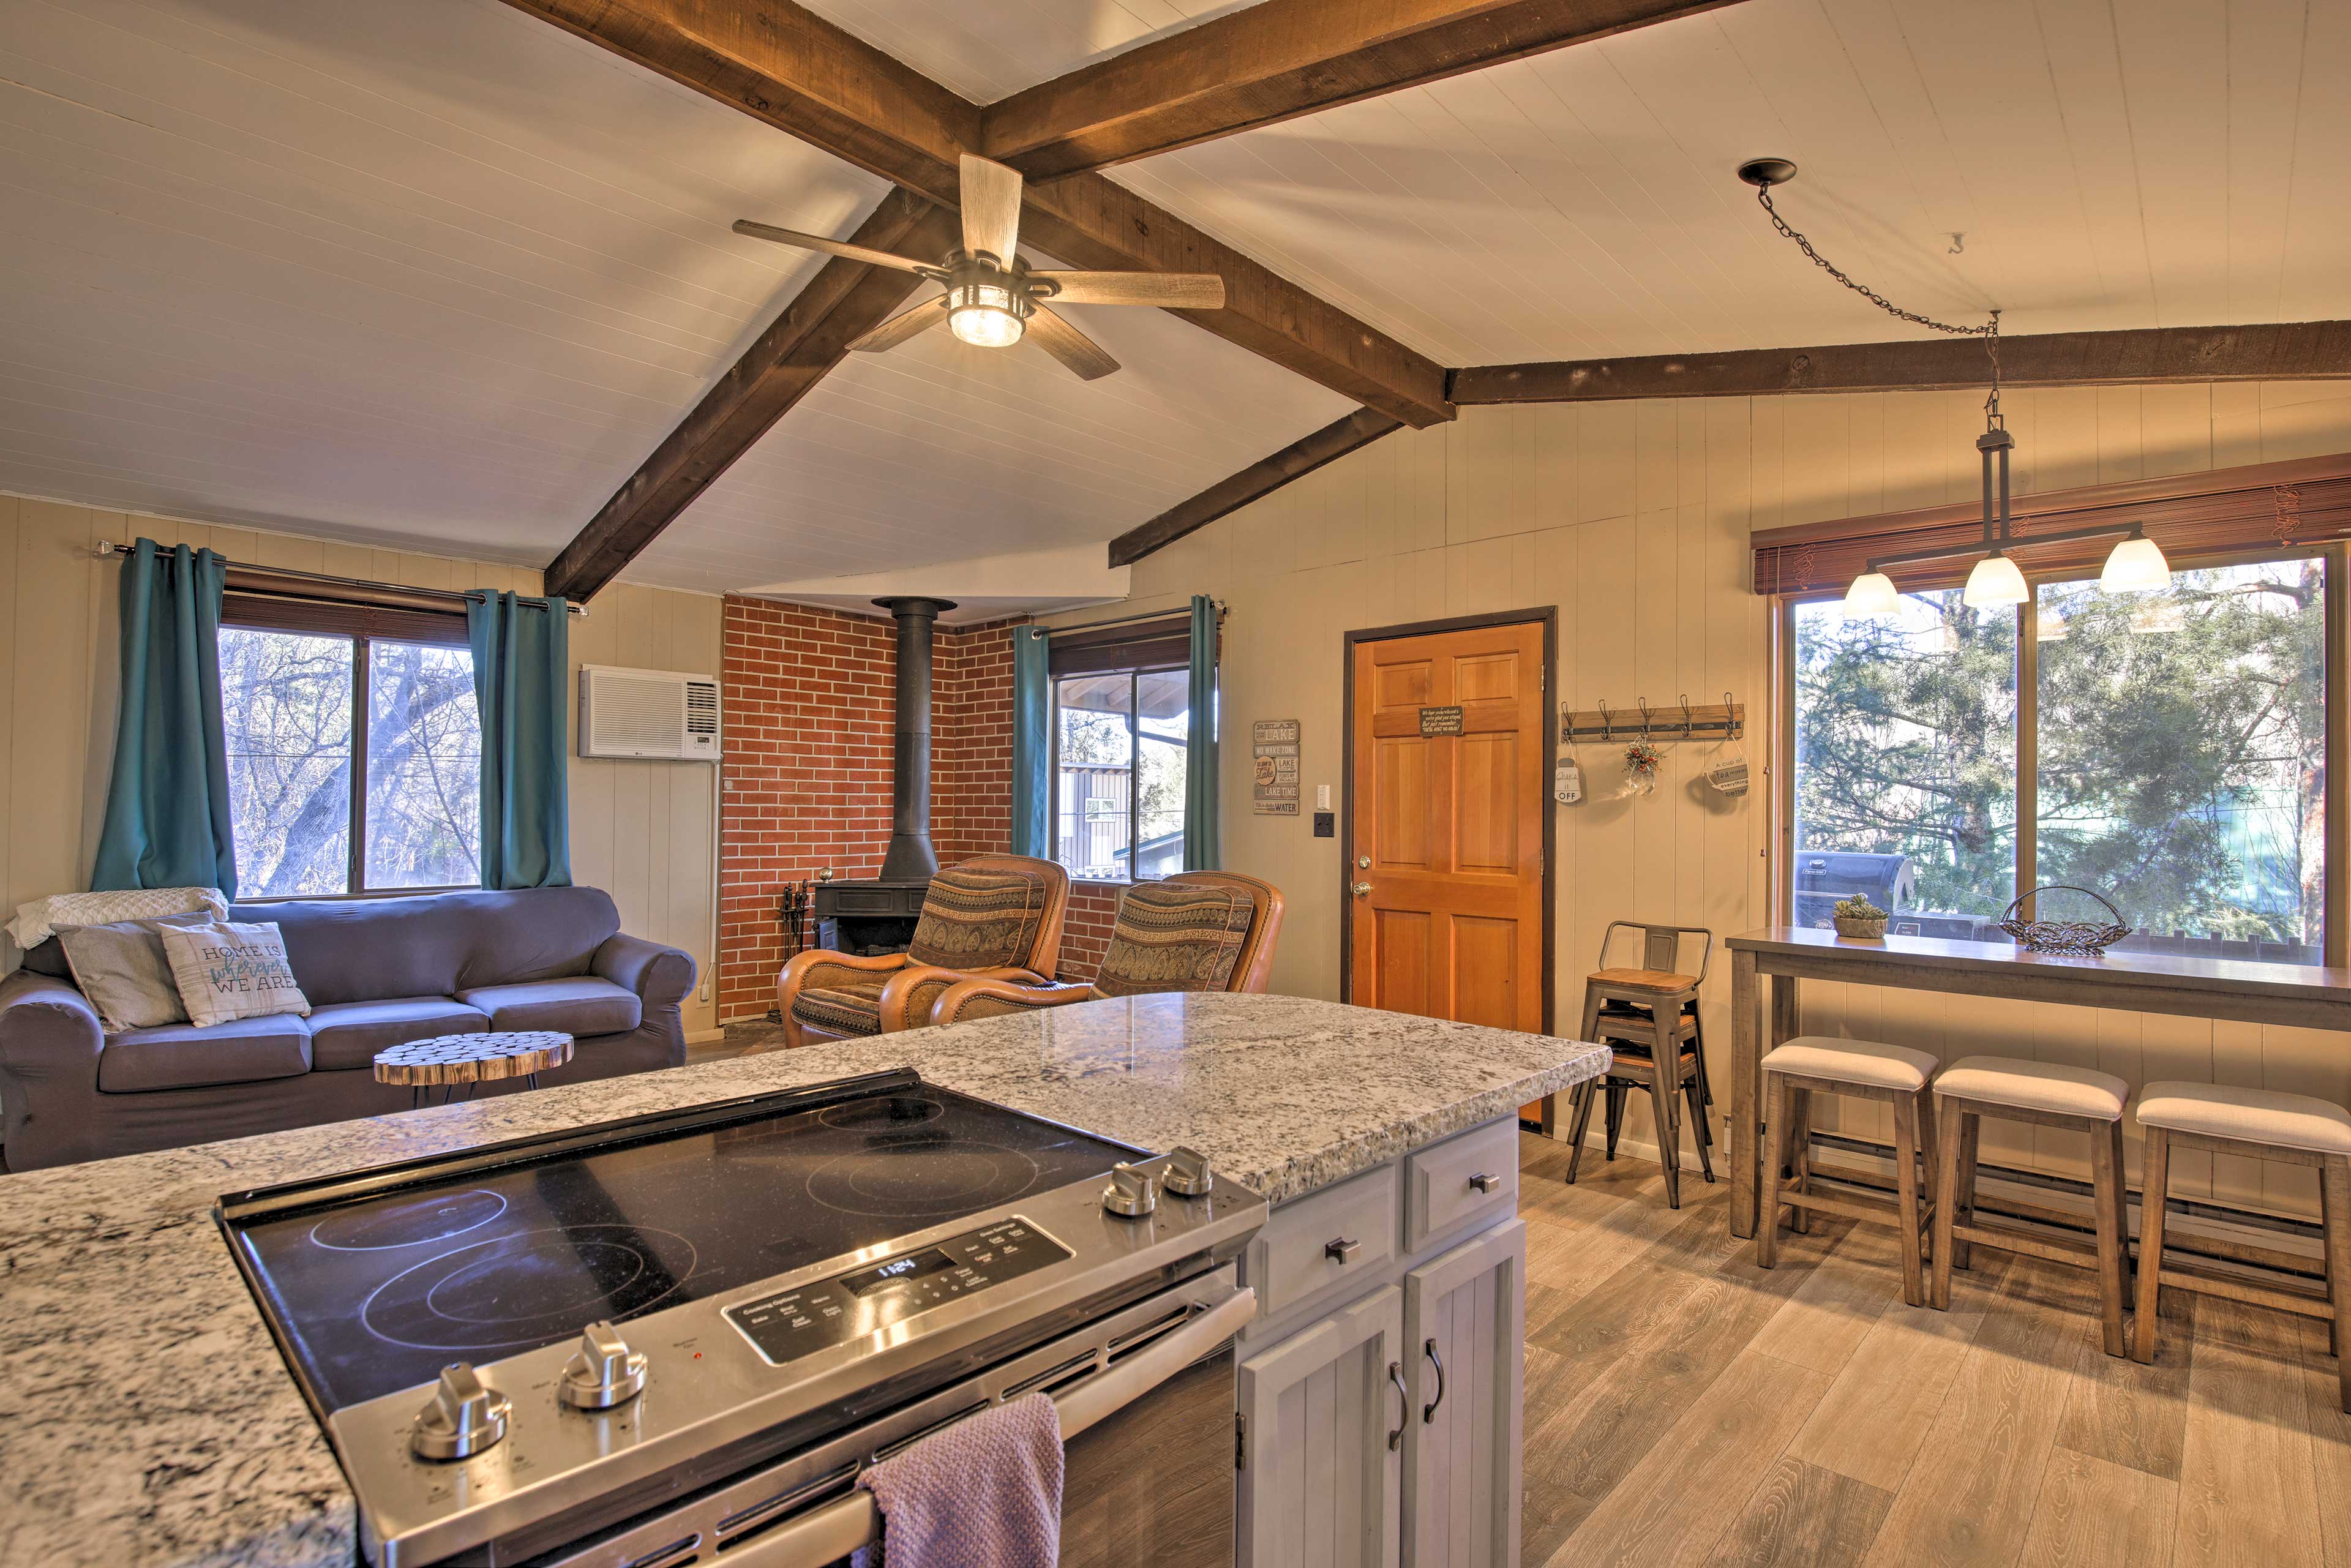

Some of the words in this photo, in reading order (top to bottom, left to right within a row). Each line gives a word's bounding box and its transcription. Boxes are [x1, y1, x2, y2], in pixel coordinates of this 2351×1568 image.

[1265, 729, 1294, 740] LAKE
[1256, 767, 1274, 779] Lake
[1716, 771, 1730, 780] tea
[1720, 779, 1749, 789] everything
[1265, 787, 1280, 796] LAKE
[1281, 787, 1296, 796] TIME
[1275, 803, 1296, 812] WATER
[201, 946, 263, 960] HOME
[264, 946, 282, 956] IS
[210, 951, 287, 982] wherever
[211, 978, 250, 993] WE
[257, 976, 293, 990] ARE
[993, 1223, 1016, 1232] Settings
[878, 1259, 916, 1277] 11:24
[954, 1267, 971, 1275] Timer
[743, 1302, 773, 1315] Cooking
[772, 1294, 801, 1306] Options
[811, 1295, 831, 1304] Warm
[825, 1308, 842, 1317] Light
[751, 1315, 769, 1324] Bake
[792, 1318, 812, 1328] Clean
